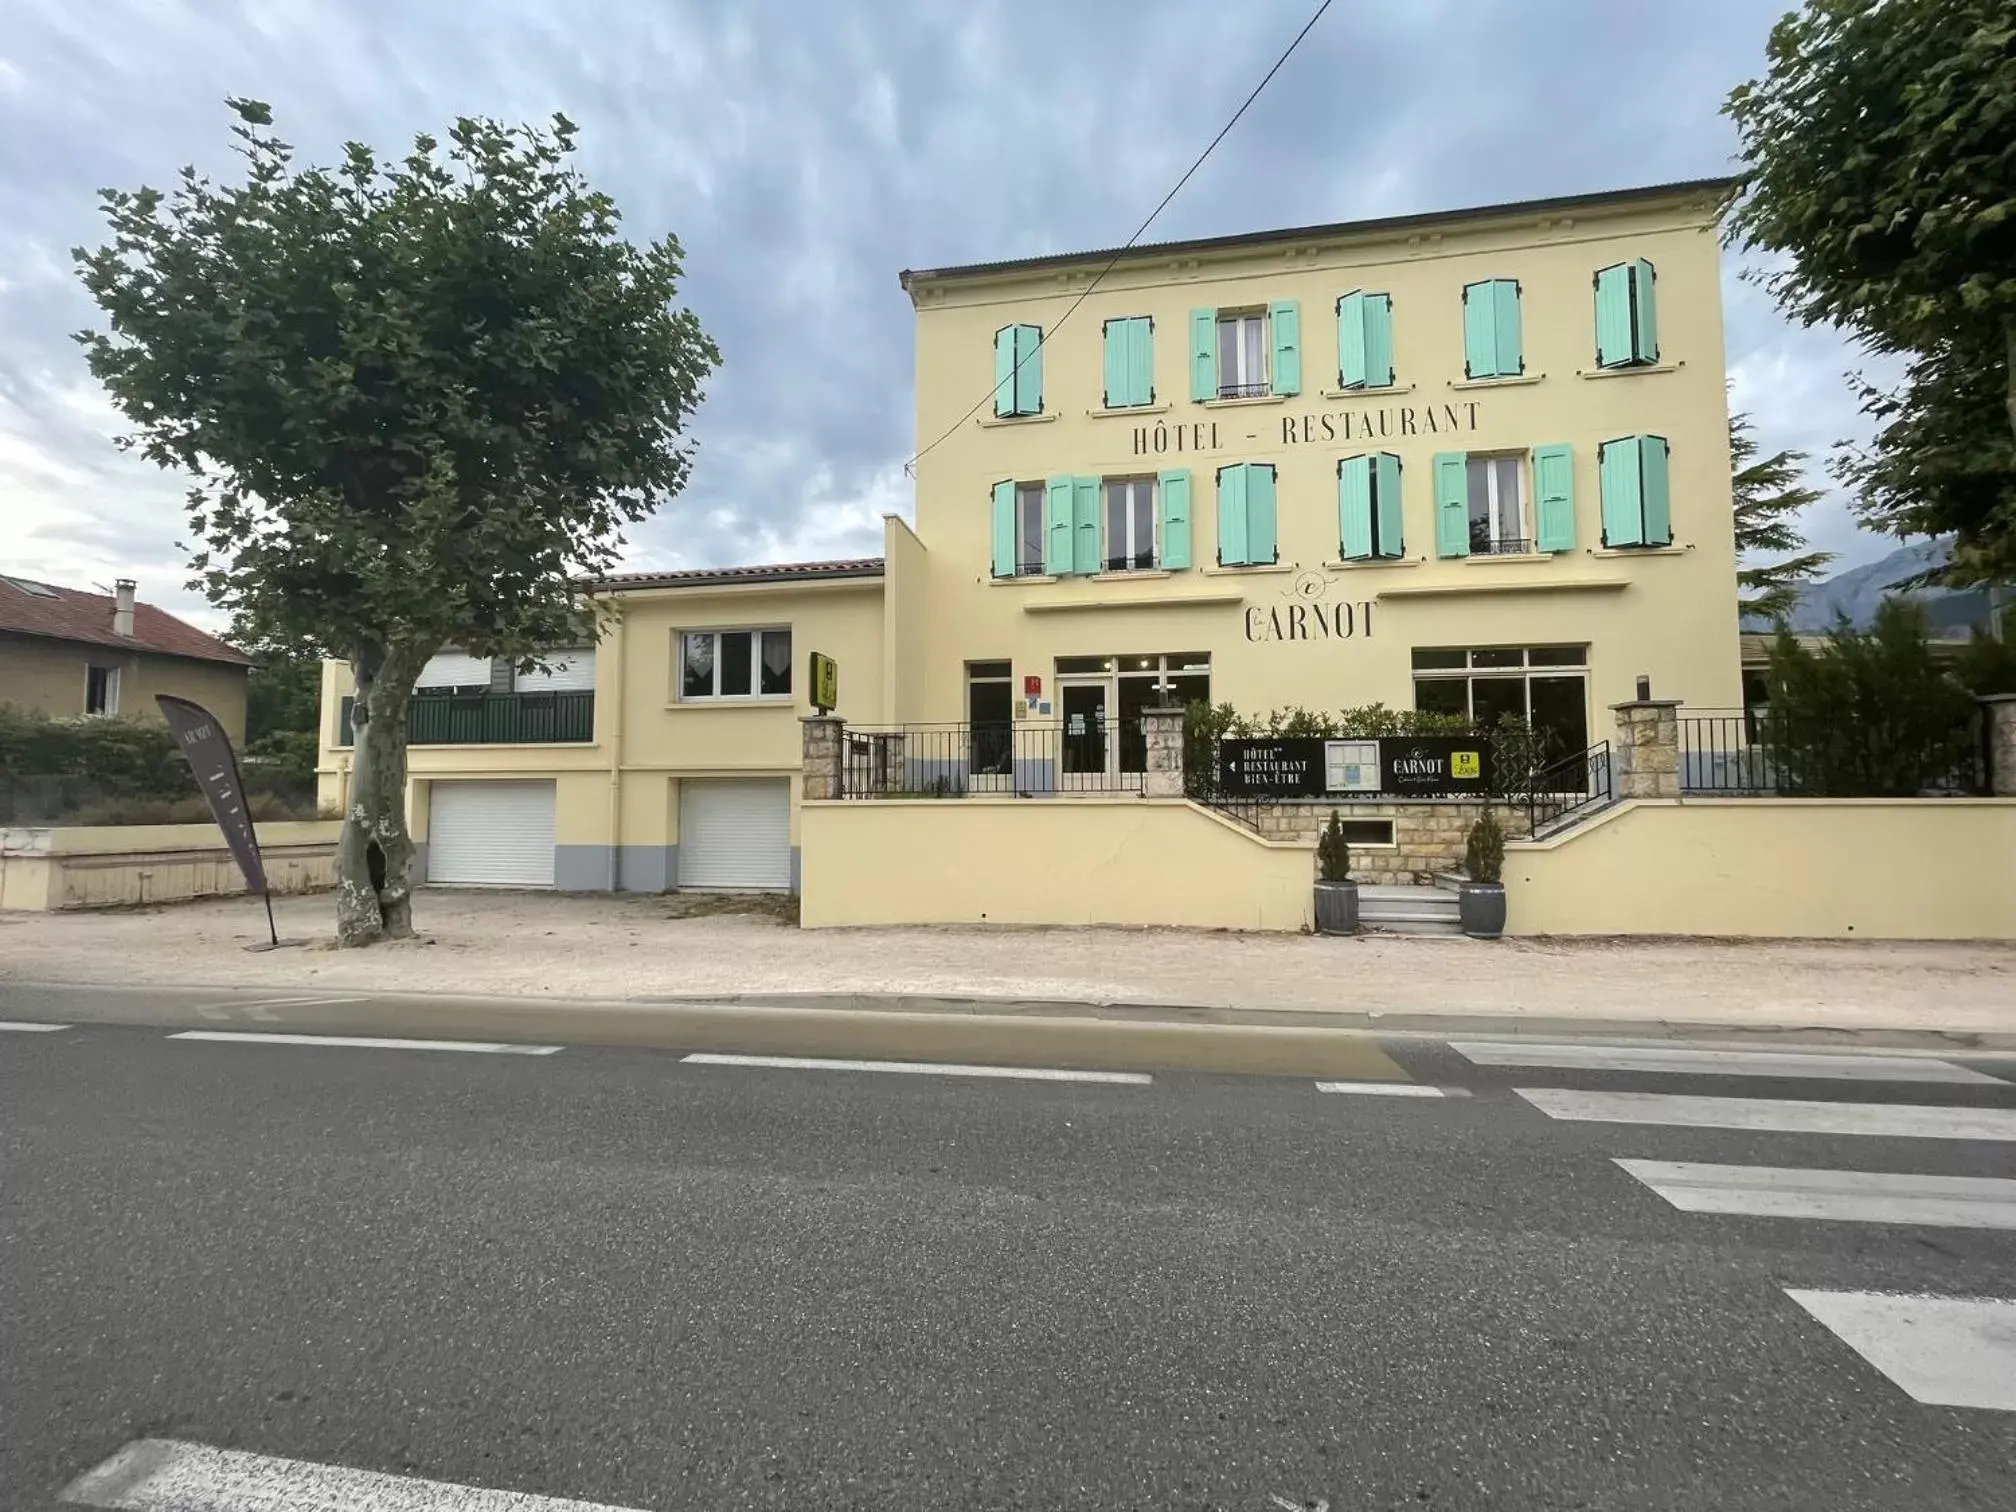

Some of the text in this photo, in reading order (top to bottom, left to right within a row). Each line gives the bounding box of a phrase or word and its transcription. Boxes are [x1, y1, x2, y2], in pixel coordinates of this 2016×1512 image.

[1133, 418, 1224, 455] HÔTEL
[1282, 401, 1481, 444] RESTAURANT
[1245, 601, 1379, 642] CARNOT
[1243, 760, 1308, 772] RESTAURANT
[1393, 758, 1444, 774] CARNOT
